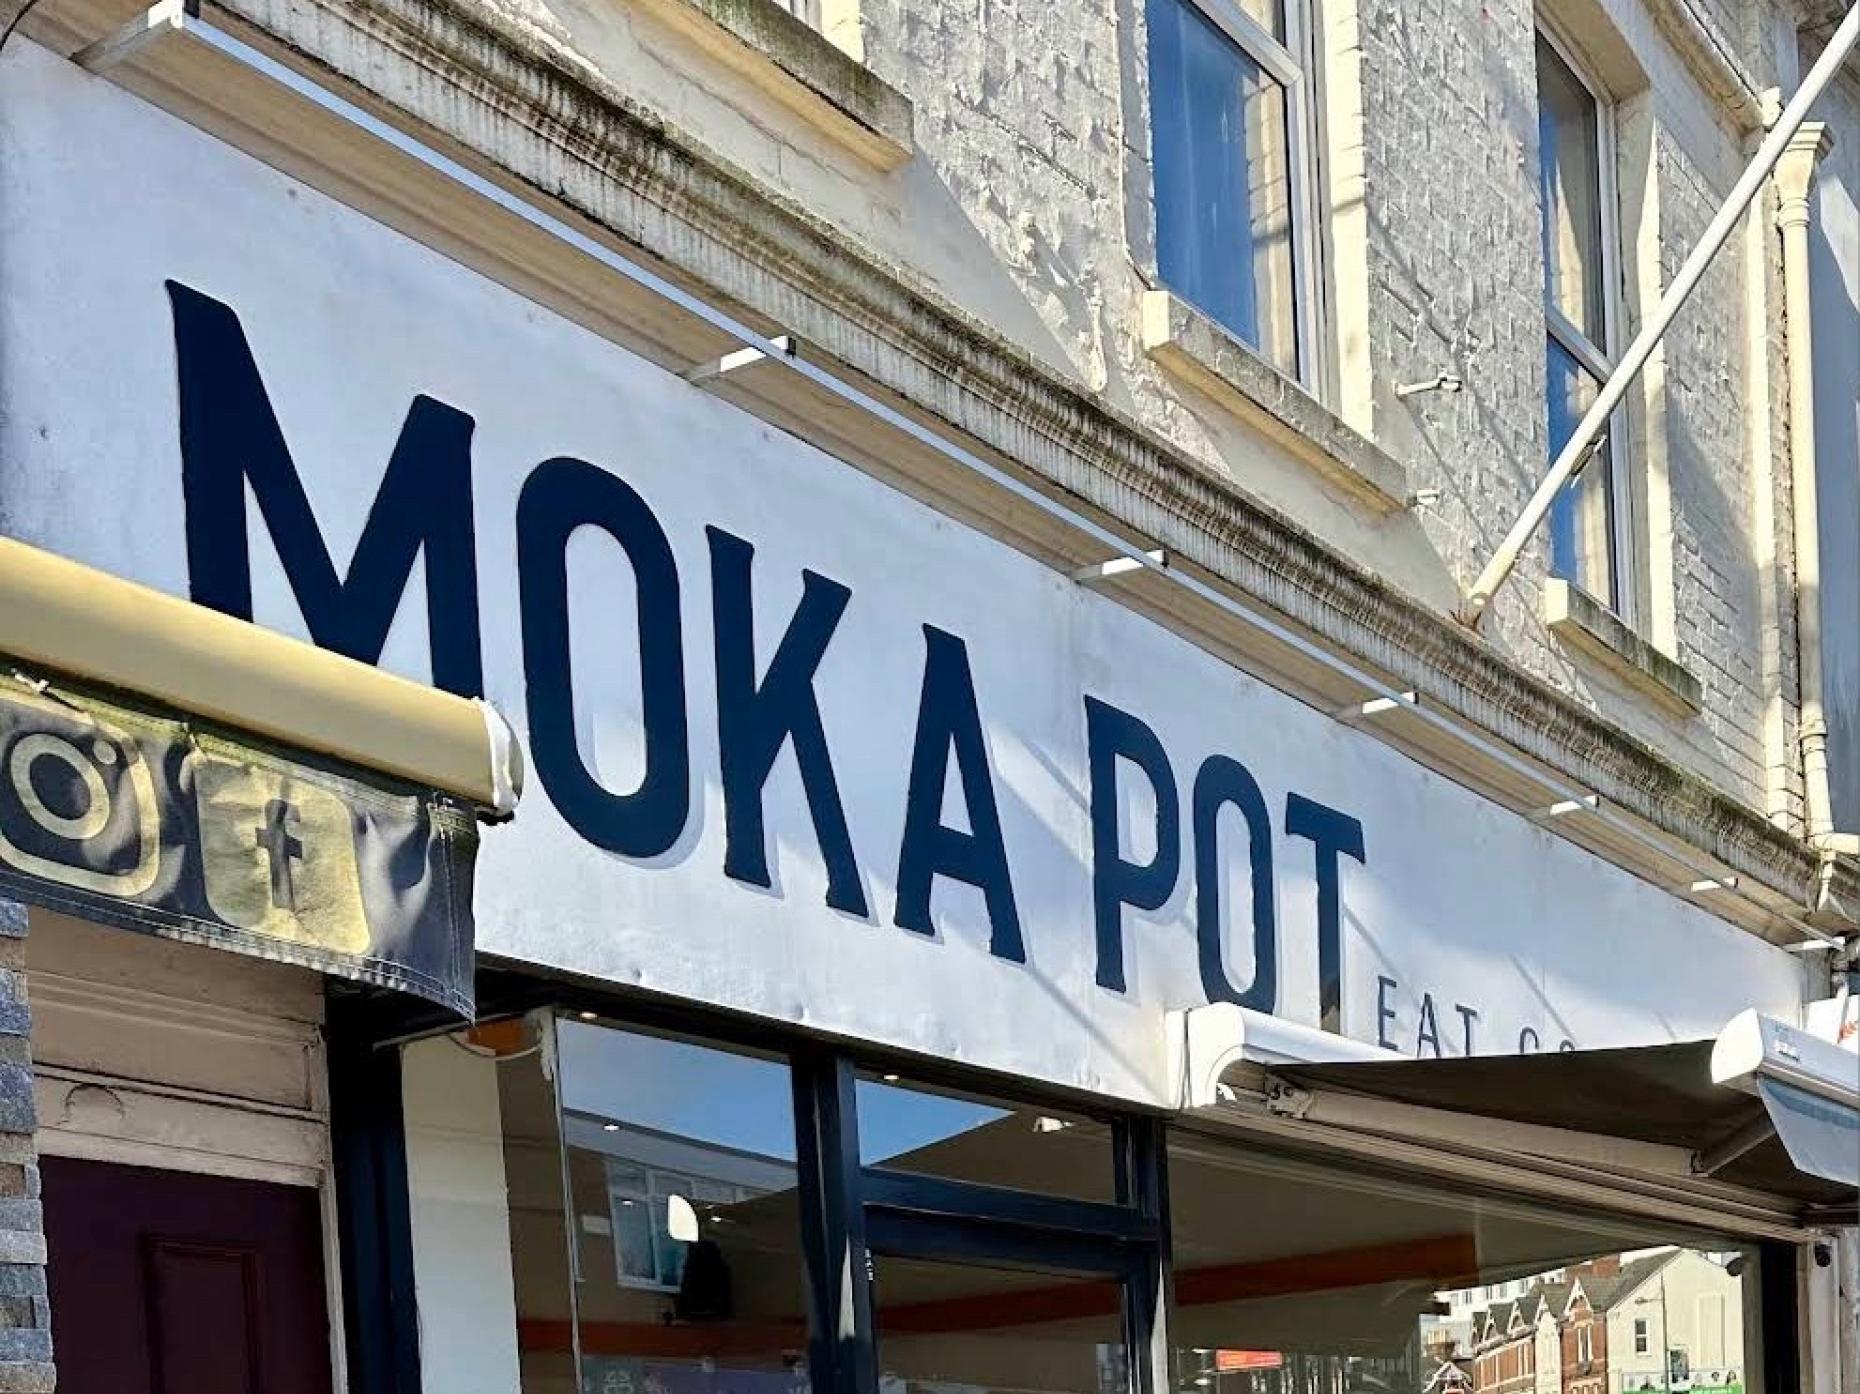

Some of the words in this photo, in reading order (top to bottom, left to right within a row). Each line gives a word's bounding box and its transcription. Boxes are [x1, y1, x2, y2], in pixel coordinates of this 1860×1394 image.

[165, 279, 1027, 965] MOKA
[1084, 694, 1366, 1037] POT
[1377, 975, 1478, 1058] EAT
